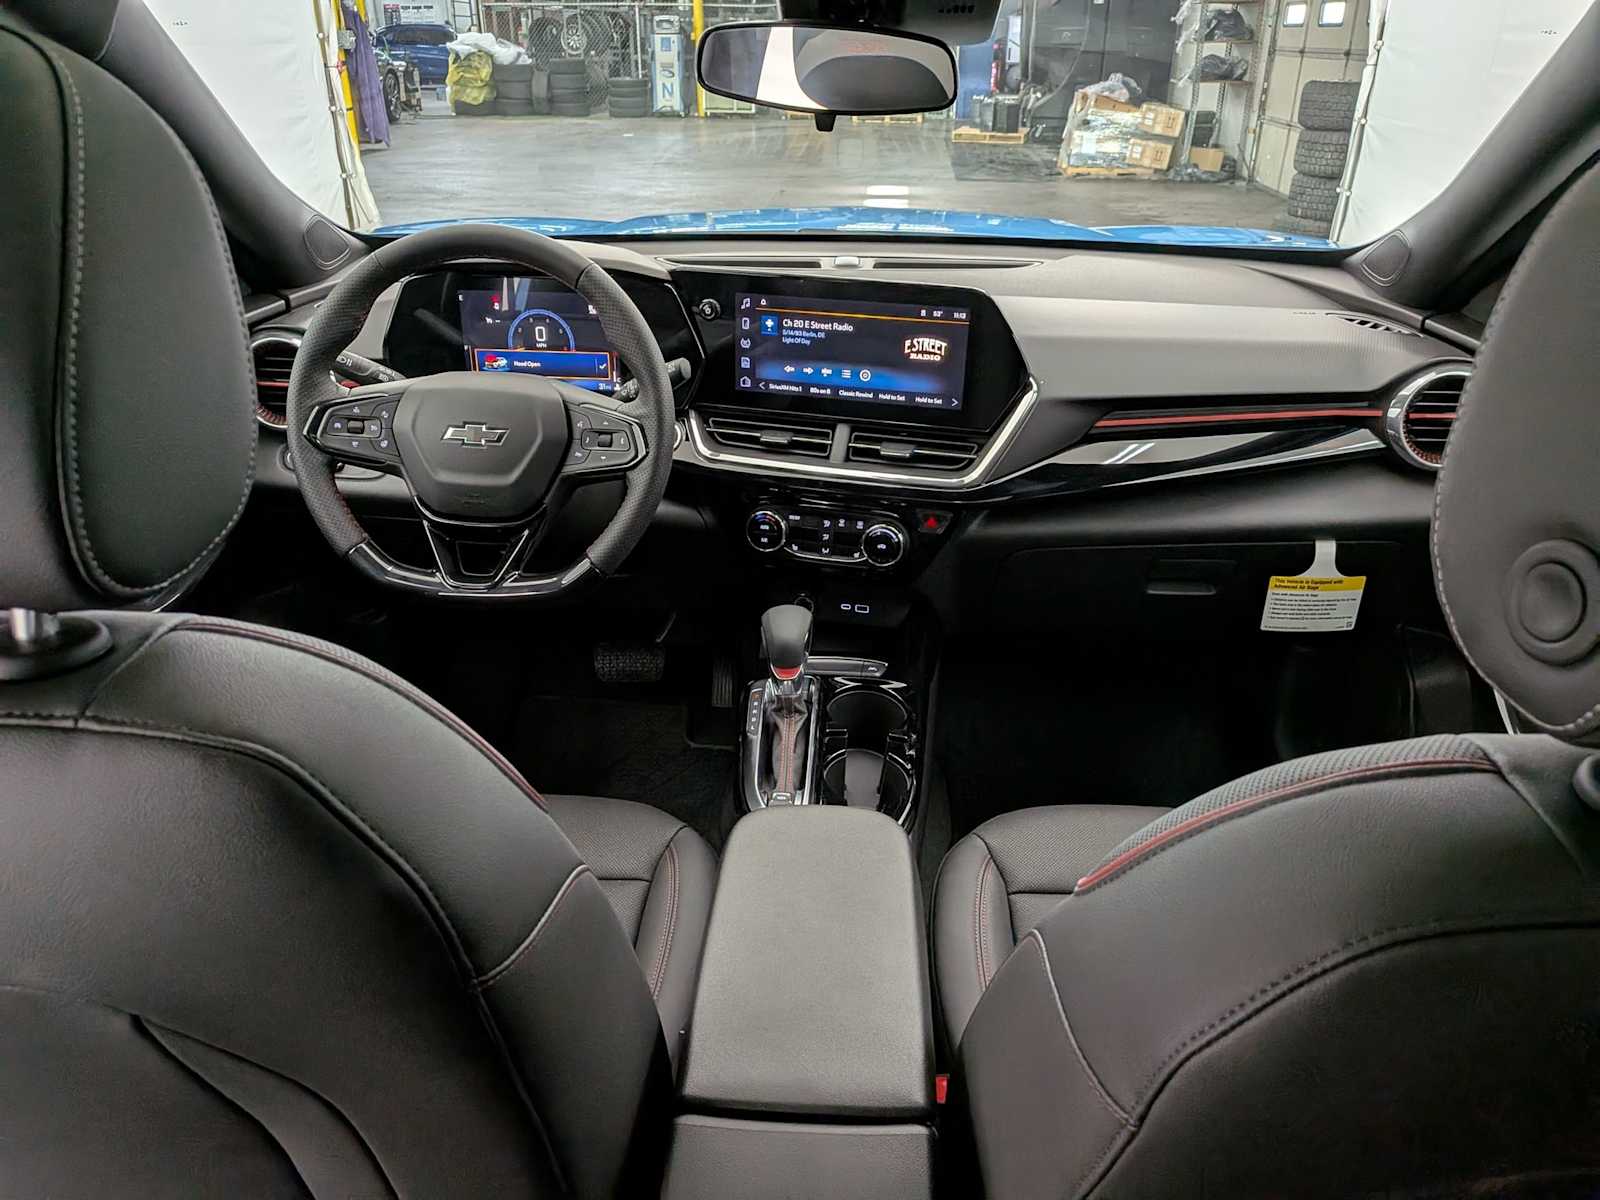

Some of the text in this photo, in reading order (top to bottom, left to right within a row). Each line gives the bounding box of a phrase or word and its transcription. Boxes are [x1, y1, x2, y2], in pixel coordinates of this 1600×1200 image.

[782, 318, 854, 332] Ch 20 E Street Radio
[534, 326, 546, 342] 0
[782, 336, 794, 344] Light
[904, 336, 948, 356] E STREET
[909, 353, 942, 362] RADIO
